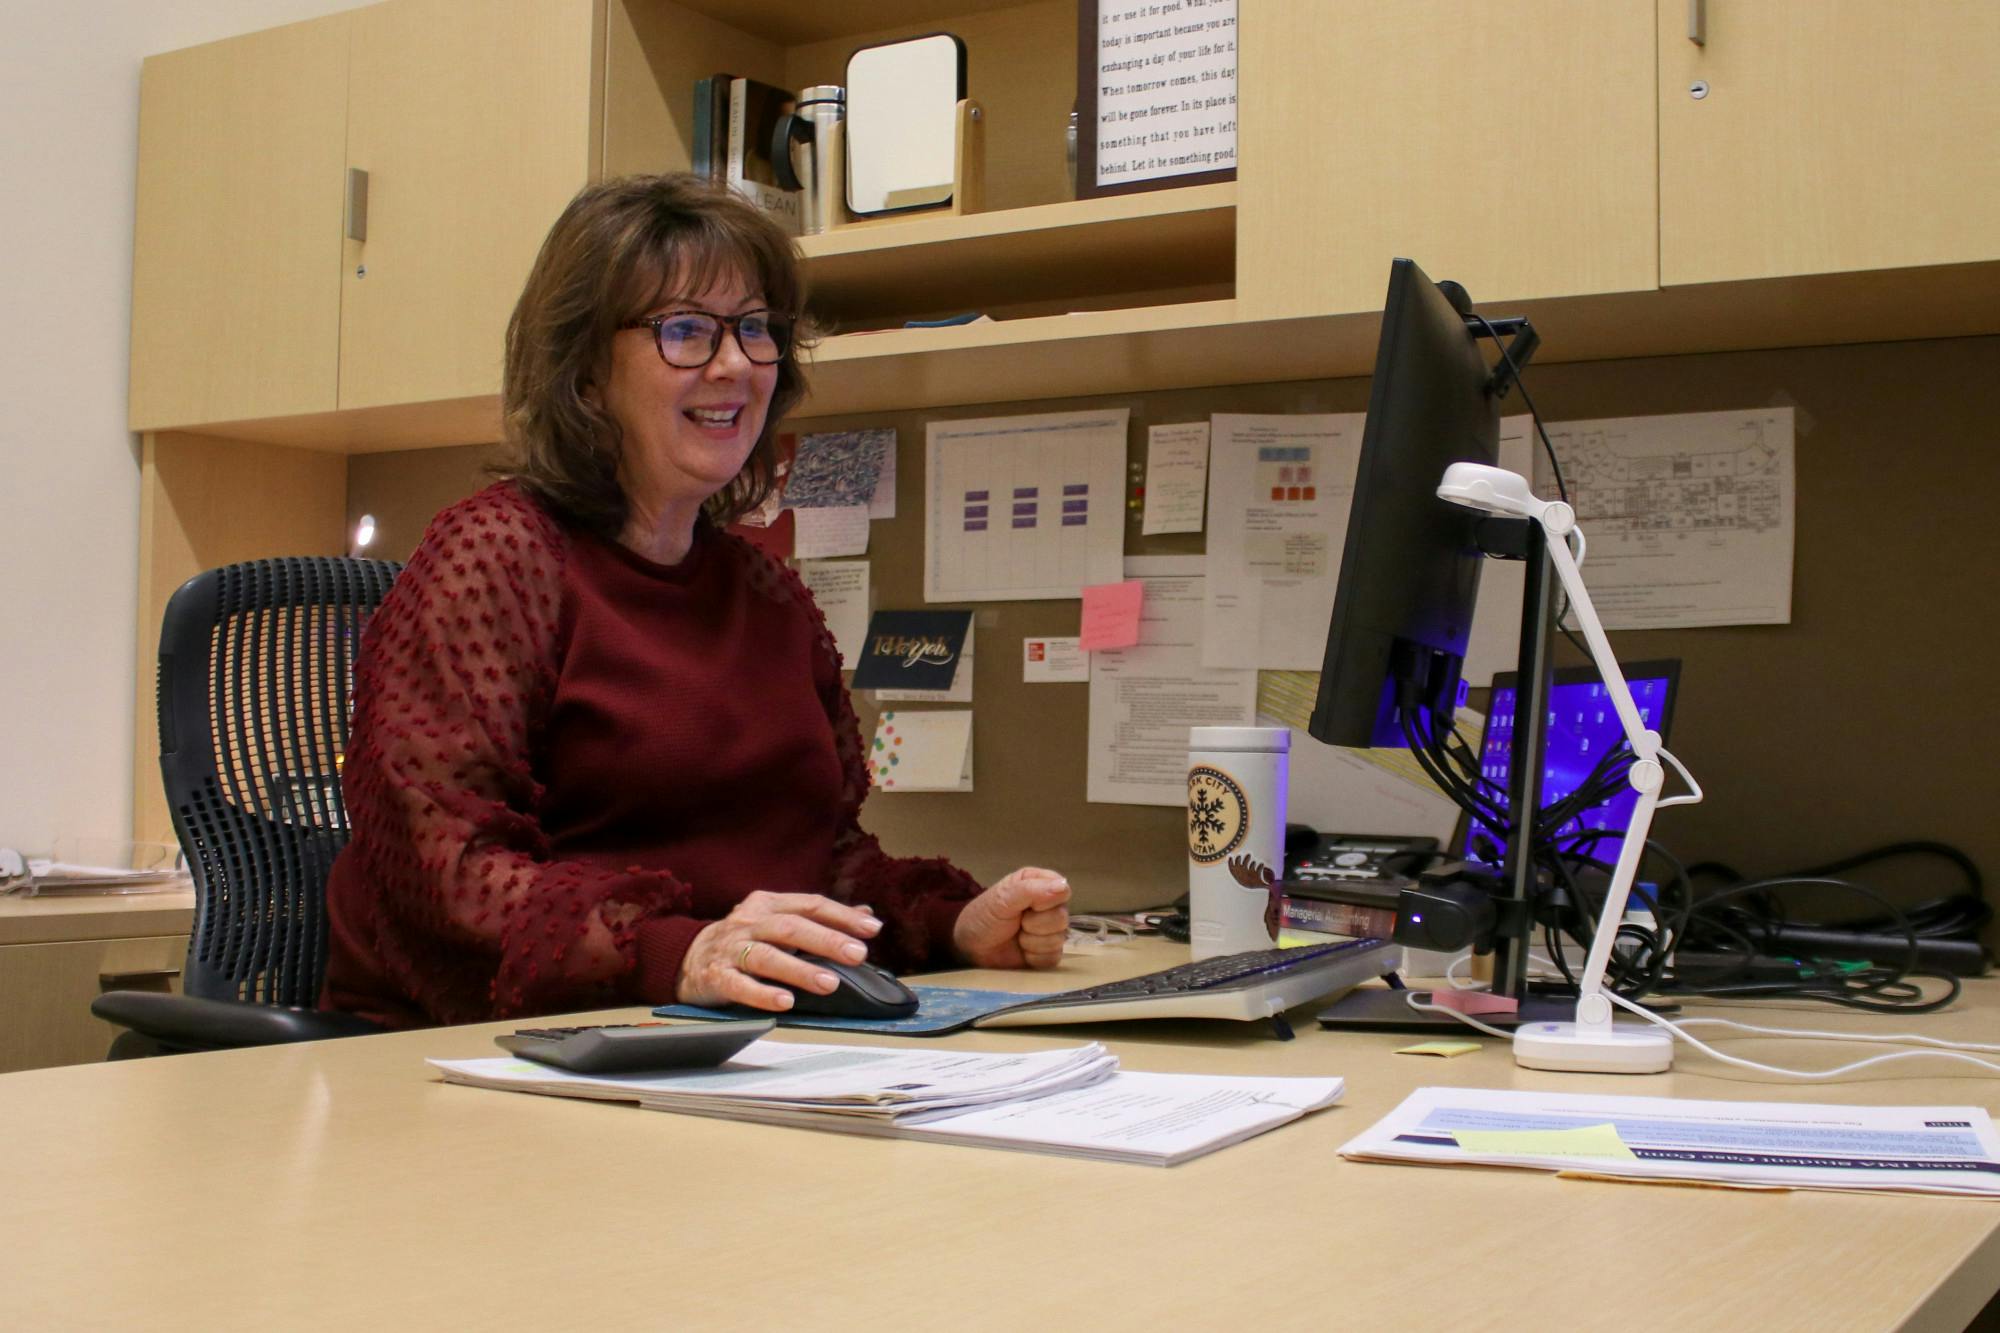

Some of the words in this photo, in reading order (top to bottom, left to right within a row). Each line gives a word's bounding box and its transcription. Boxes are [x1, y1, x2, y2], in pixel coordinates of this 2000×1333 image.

[1102, 14, 1108, 24] it
[1113, 14, 1120, 22] or
[1125, 12, 1136, 20] use
[1140, 8, 1146, 17] it
[1149, 5, 1160, 16] for
[1102, 37, 1122, 48] today
[1125, 36, 1131, 44] is
[1134, 28, 1171, 43] important
[1175, 23, 1203, 35] because
[1206, 21, 1220, 32] you
[1222, 17, 1235, 26] are
[1153, 54, 1164, 66] day
[1169, 52, 1176, 61] of
[1179, 50, 1196, 62] your
[1199, 46, 1211, 57] life
[1214, 44, 1224, 54] for
[1102, 85, 1124, 97] When
[1127, 79, 1167, 93] tomorrow
[1201, 71, 1217, 82] this
[1221, 68, 1235, 80] day
[1101, 111, 1116, 123] will
[1119, 109, 1127, 120] be
[1130, 108, 1148, 122] gone
[1182, 100, 1190, 110] In
[1192, 98, 1202, 109] its
[1206, 96, 1226, 110] place
[1229, 94, 1236, 104] is
[1100, 133, 1146, 150] something
[1151, 131, 1169, 143] that
[1173, 130, 1189, 142] you
[1194, 126, 1214, 136] have
[1219, 121, 1236, 132] left
[1132, 160, 1145, 171] Let
[1149, 158, 1154, 168] it
[1158, 157, 1167, 166] be
[1170, 151, 1211, 166] something
[755, 191, 796, 215] LEAN
[1205, 777, 1230, 795] CITY
[1193, 843, 1215, 855] UTAH
[1701, 1154, 1756, 1163] Case
[1761, 1156, 1852, 1167] Student
[1860, 1160, 1909, 1168] IMA
